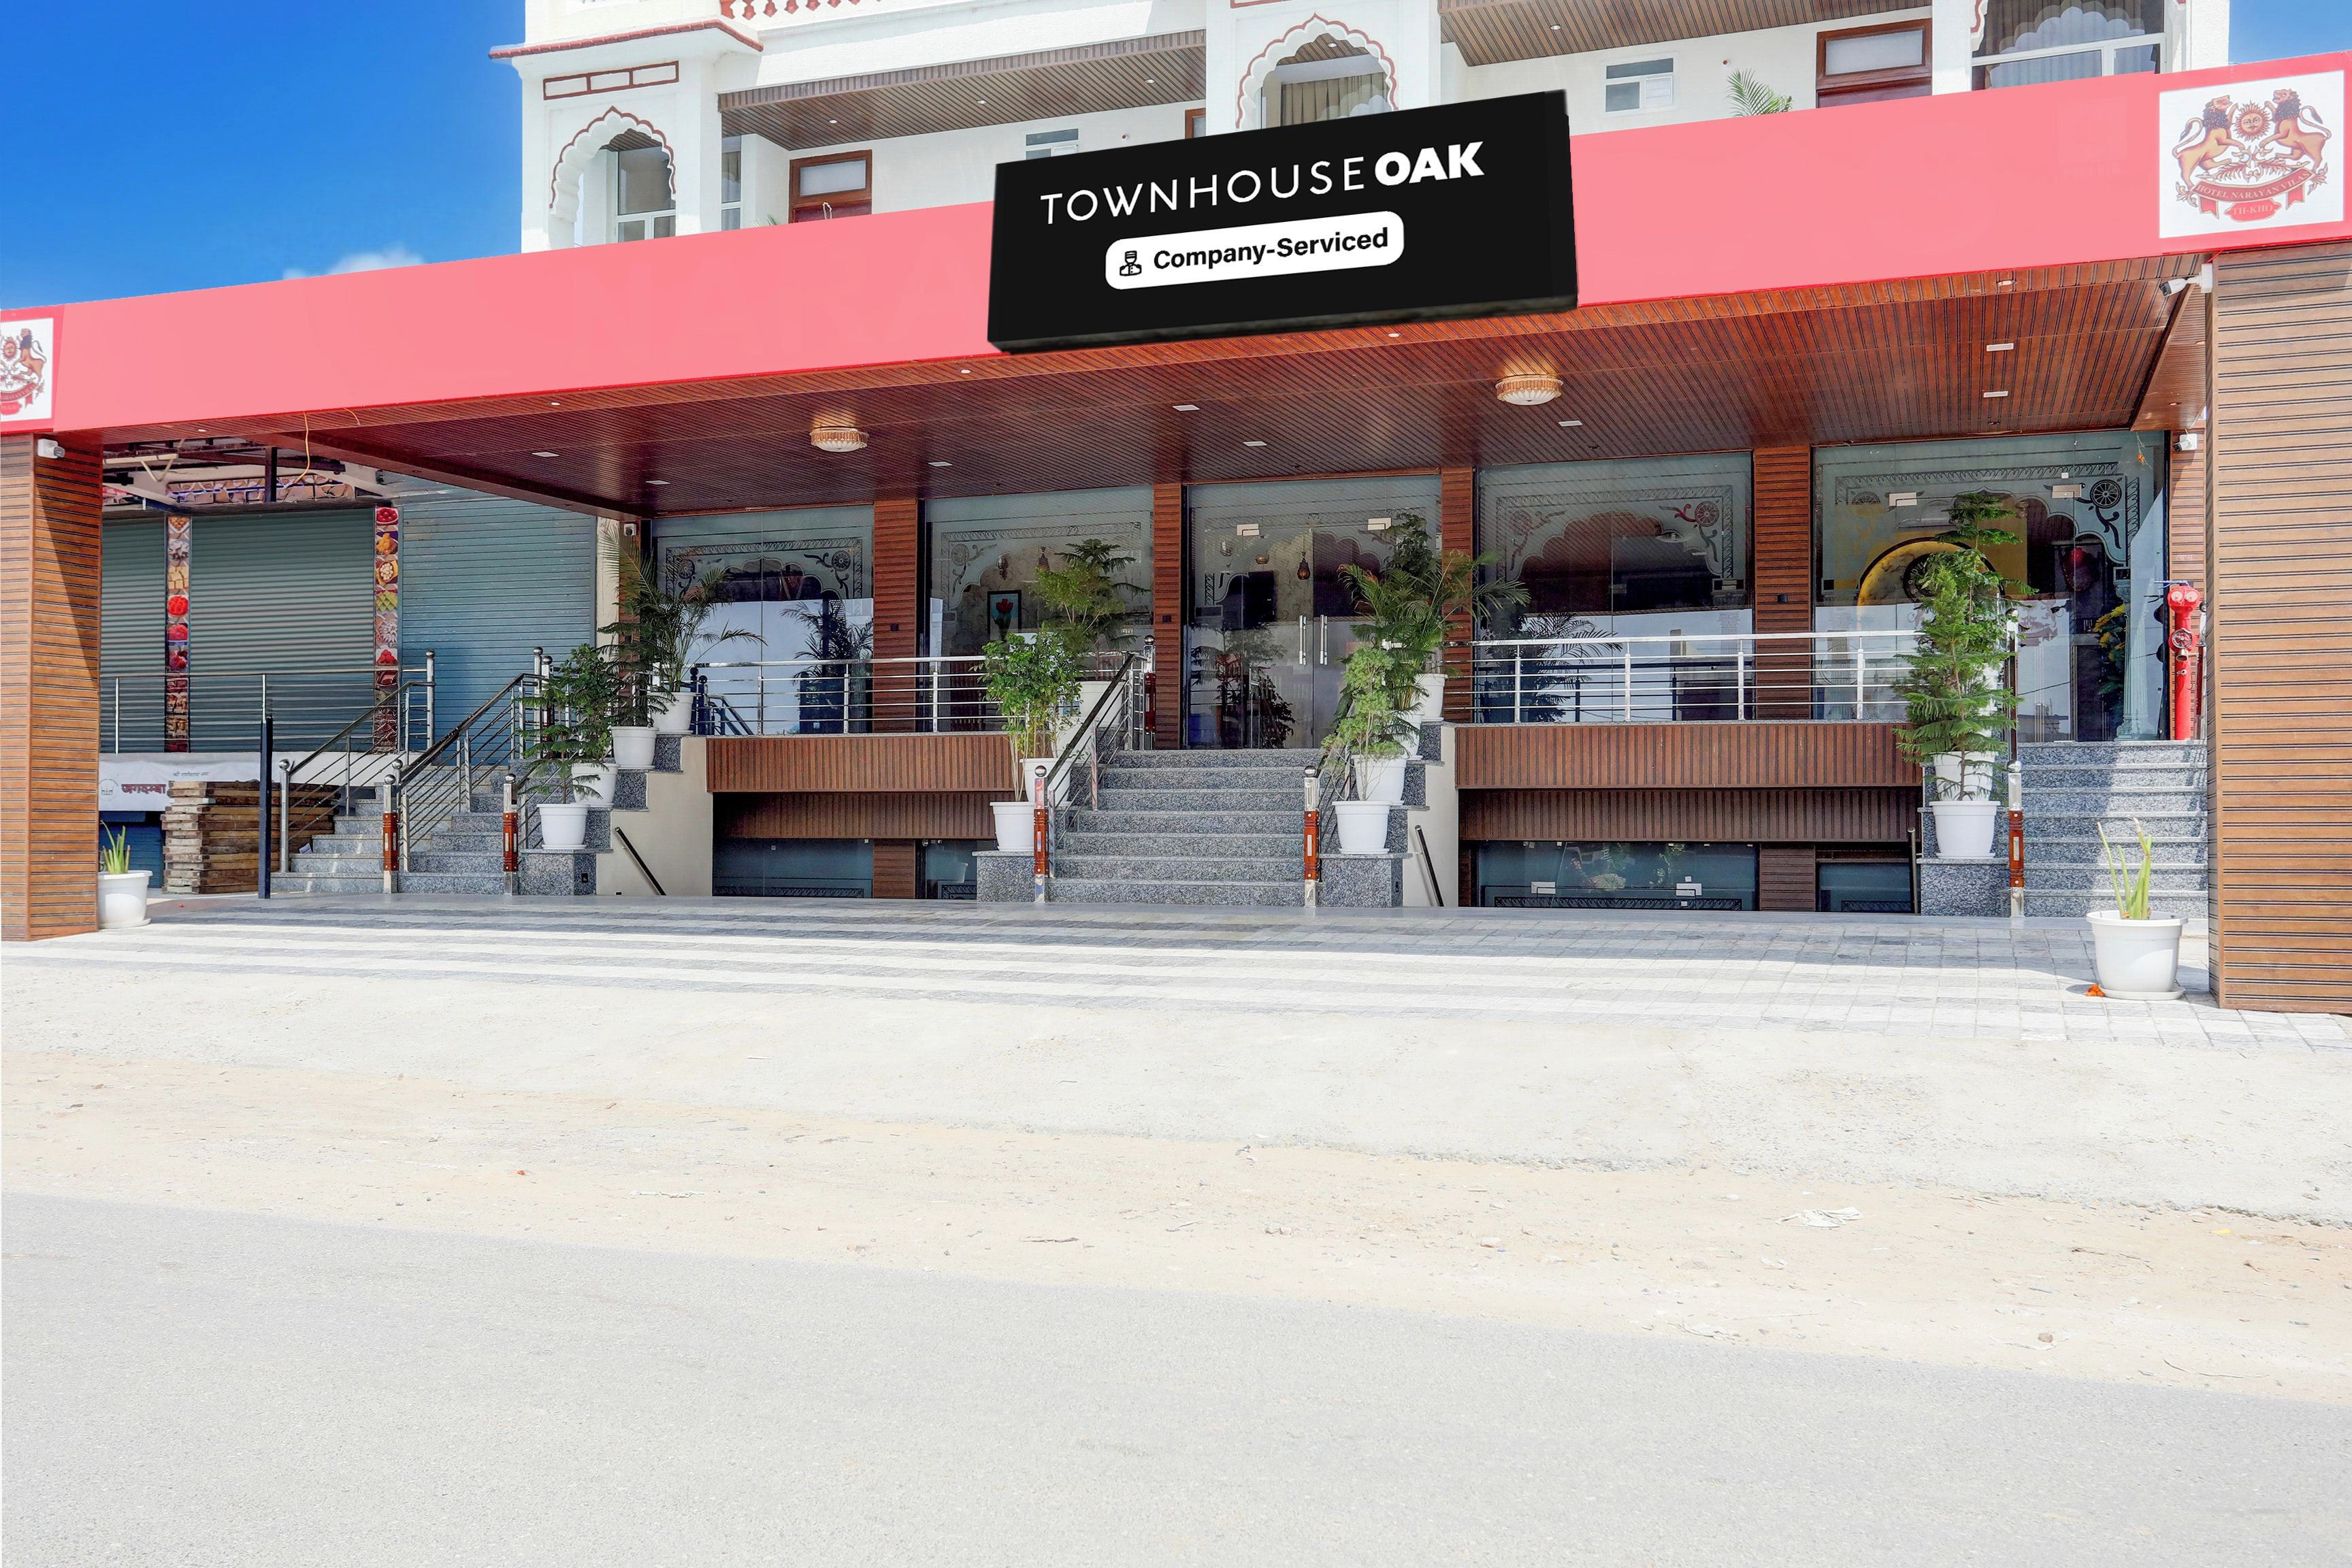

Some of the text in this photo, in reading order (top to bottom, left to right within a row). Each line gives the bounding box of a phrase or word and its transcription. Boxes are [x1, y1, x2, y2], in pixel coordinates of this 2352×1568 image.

[1040, 141, 1485, 225] TOWNHOUSE OAK
[2196, 171, 2310, 199] HOTEL NARAYAN VILAS
[1154, 227, 1388, 270] Company-Serviced
